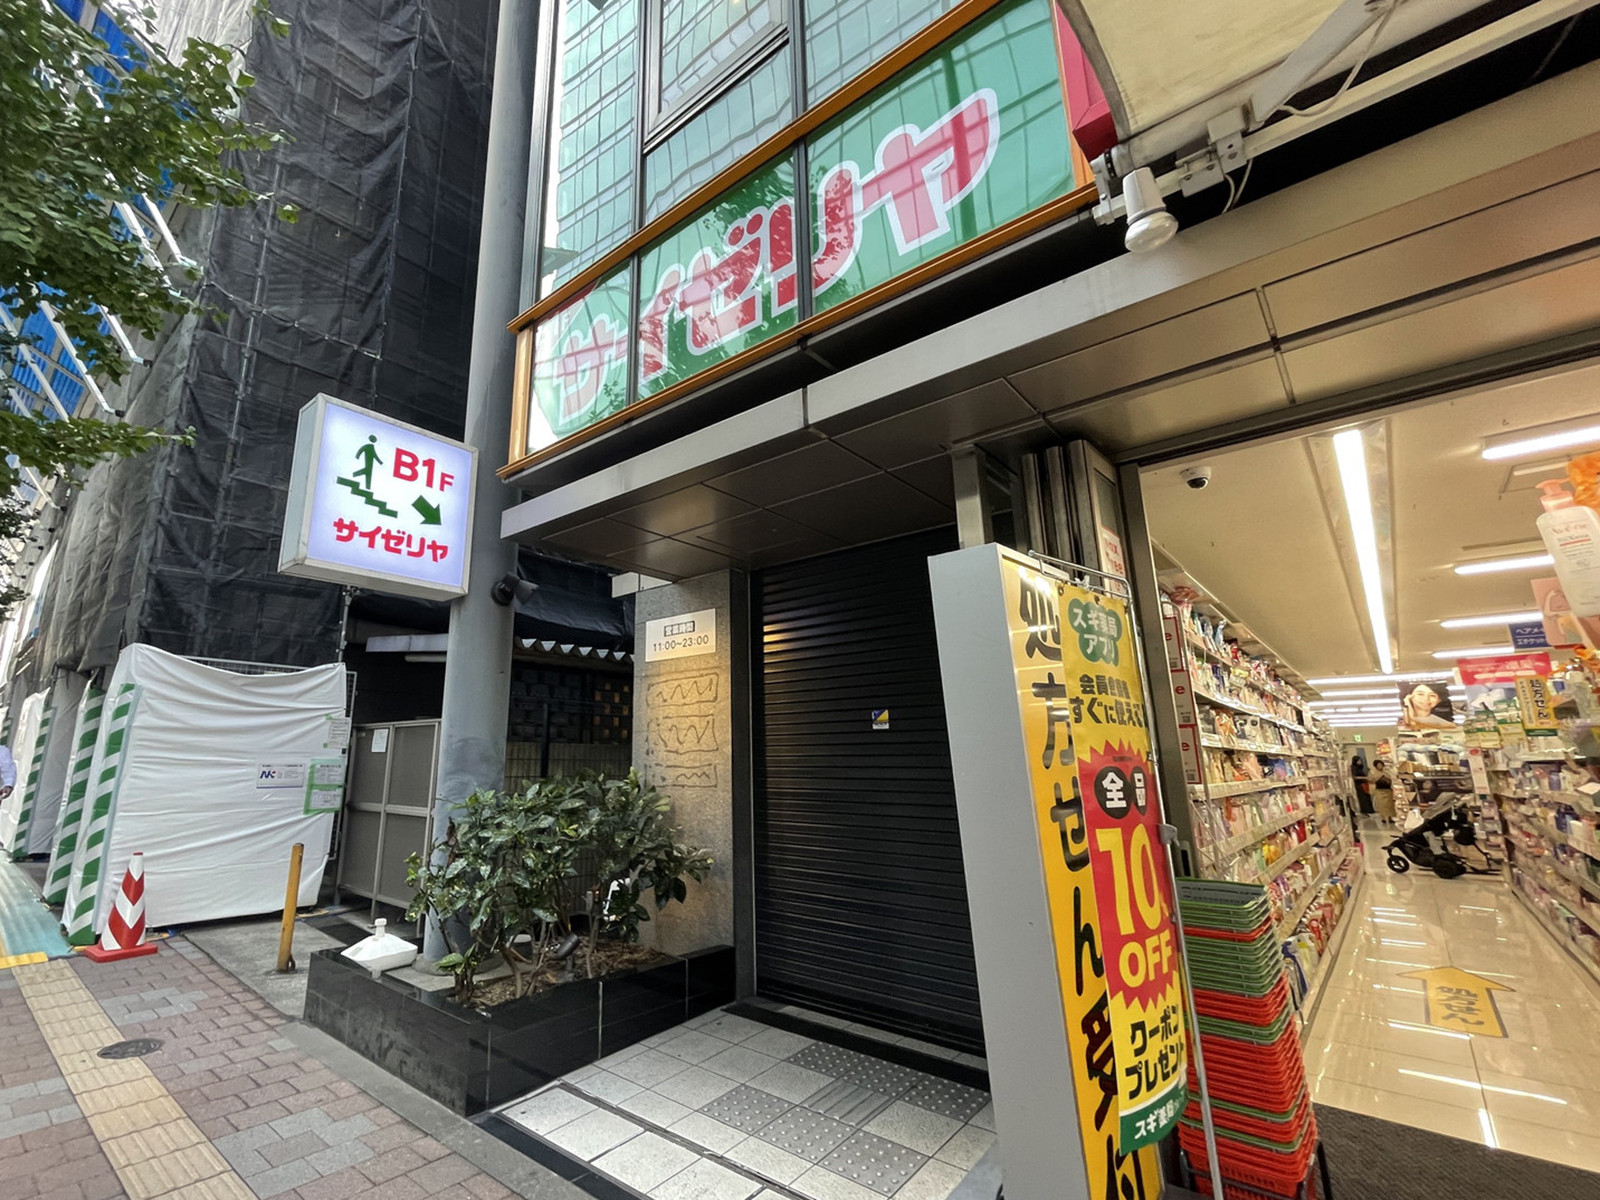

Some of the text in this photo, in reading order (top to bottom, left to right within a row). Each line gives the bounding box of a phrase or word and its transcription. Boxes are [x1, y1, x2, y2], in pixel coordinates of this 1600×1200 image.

[556, 88, 1000, 420] サイゼリヤ
[393, 447, 454, 492] B1F
[333, 517, 449, 563] サイゼリヤ
[1073, 608, 1118, 638] スギ薬局
[1084, 634, 1115, 658] アプリ
[1102, 771, 1146, 808] 全品
[1119, 929, 1172, 988] OFF
[1130, 1004, 1179, 1057] クーポン
[1125, 1036, 1184, 1100] プレゼント
